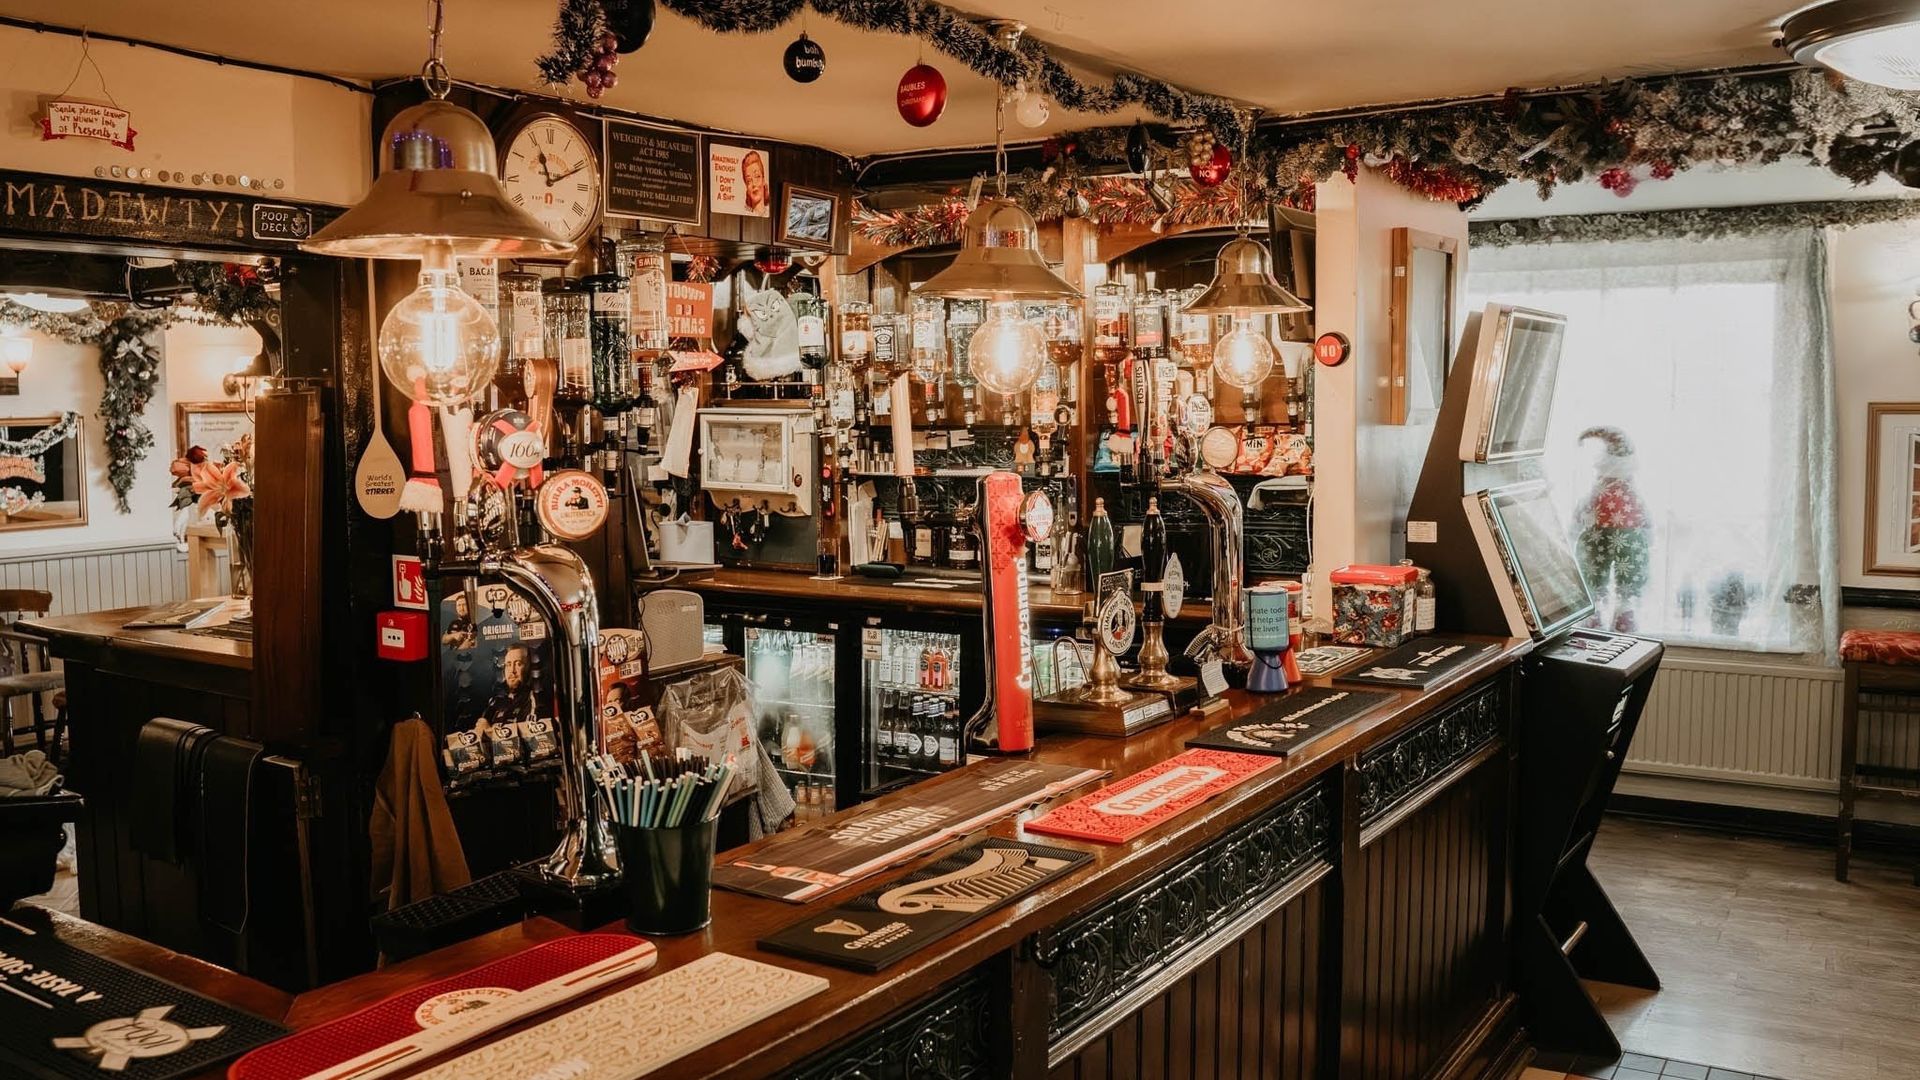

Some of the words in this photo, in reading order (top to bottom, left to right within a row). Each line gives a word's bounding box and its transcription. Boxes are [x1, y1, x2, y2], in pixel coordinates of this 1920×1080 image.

[73, 122, 111, 138] Presents
[612, 132, 648, 146] WEIGHTS
[648, 138, 655, 147] &
[656, 140, 694, 154] MEASURES
[640, 147, 653, 157] ACT
[712, 154, 739, 165] AMAZINGLY
[614, 162, 627, 171] GIN
[629, 163, 643, 173] RUM
[645, 166, 668, 177] VODKA
[715, 163, 736, 172] ENOUGH
[720, 184, 732, 193] GIVE
[261, 211, 289, 222] POOP
[261, 222, 288, 233] DECK
[1320, 344, 1336, 357] NO
[551, 481, 571, 511] BIRRA
[571, 478, 604, 509] MORETTI
[487, 590, 506, 602] KP
[508, 600, 530, 616] WIN
[1104, 600, 1120, 631] TIMOTHY
[1256, 617, 1274, 625] help
[482, 623, 514, 635] ORIGINAL
[1015, 557, 1032, 689] Cruzcampo
[1263, 625, 1280, 633] lives
[1107, 769, 1209, 811] Cruzcampo
[829, 806, 927, 841] SOUTHERN
[862, 812, 948, 844] COMFORT
[843, 921, 906, 950] GUINNESS
[22, 970, 85, 998] TASTE
[75, 990, 104, 1004] A
